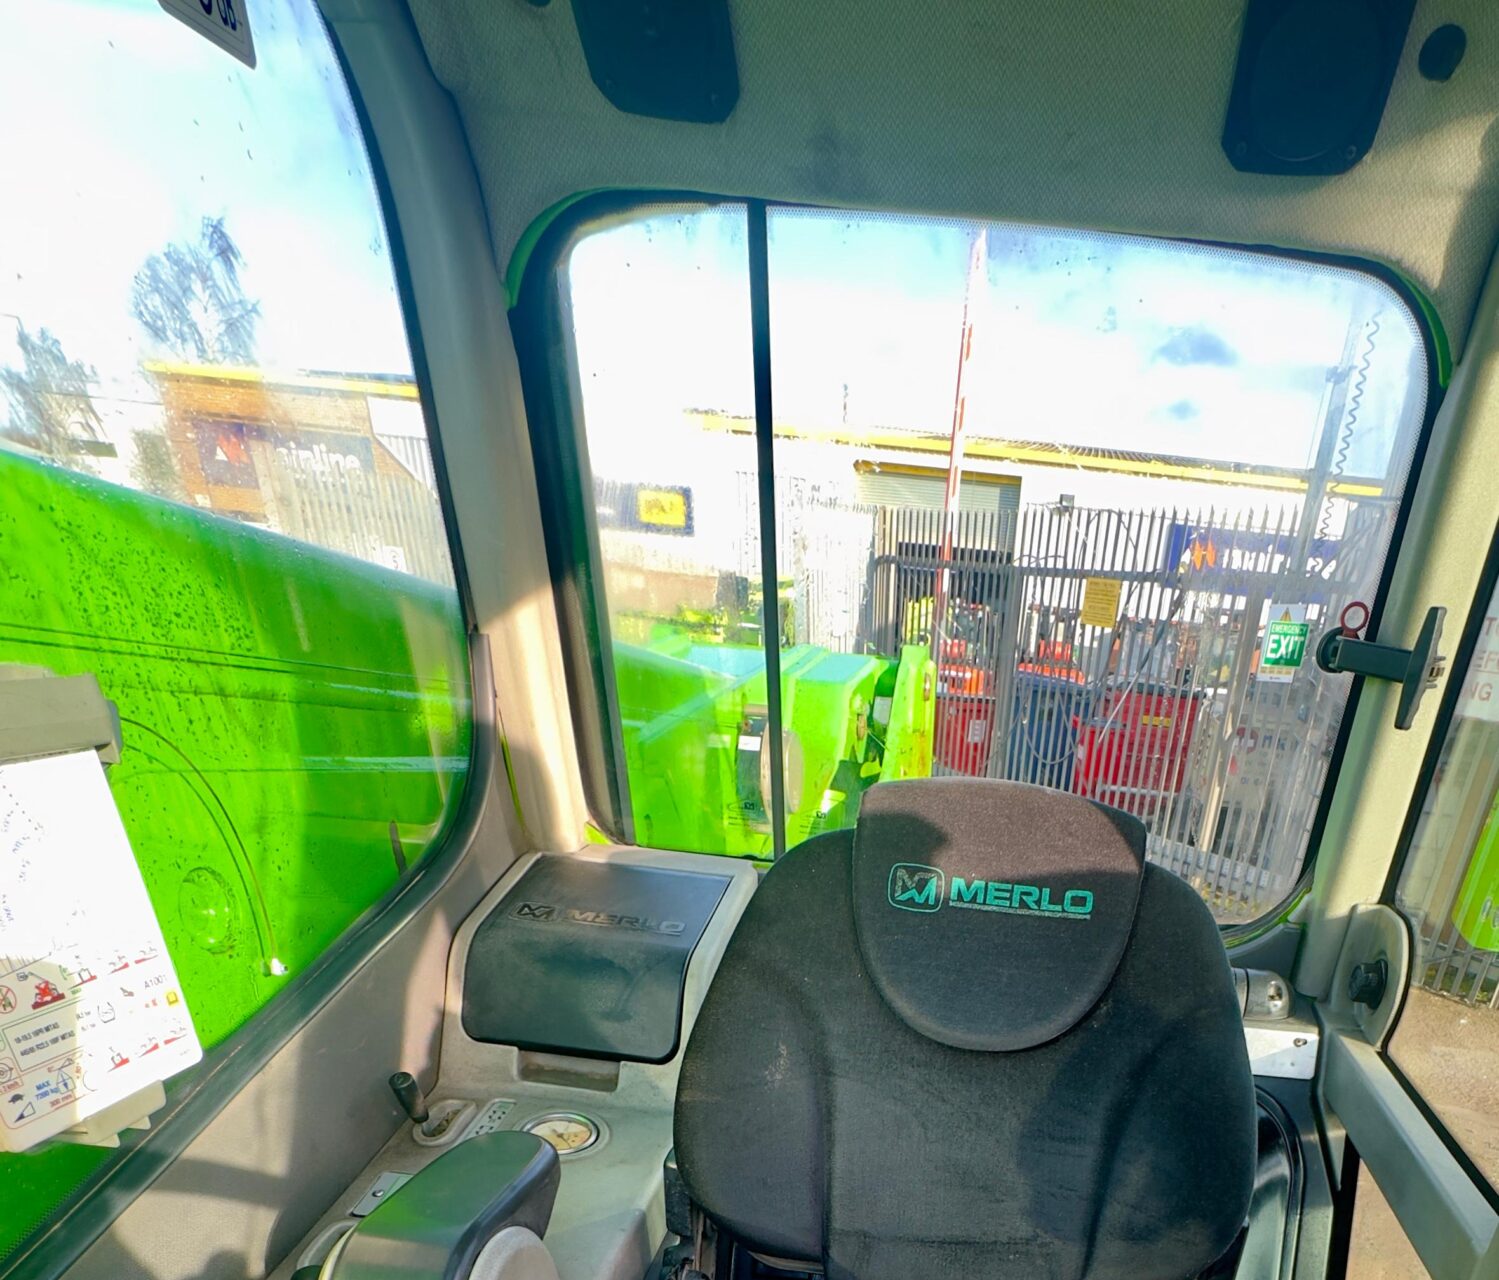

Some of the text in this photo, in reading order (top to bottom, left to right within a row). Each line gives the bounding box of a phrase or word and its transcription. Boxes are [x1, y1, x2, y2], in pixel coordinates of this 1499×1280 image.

[1266, 633, 1305, 660] EXIT
[950, 876, 1094, 914] MERLO
[567, 908, 686, 932] MERLO
[35, 1080, 51, 1091] MAX
